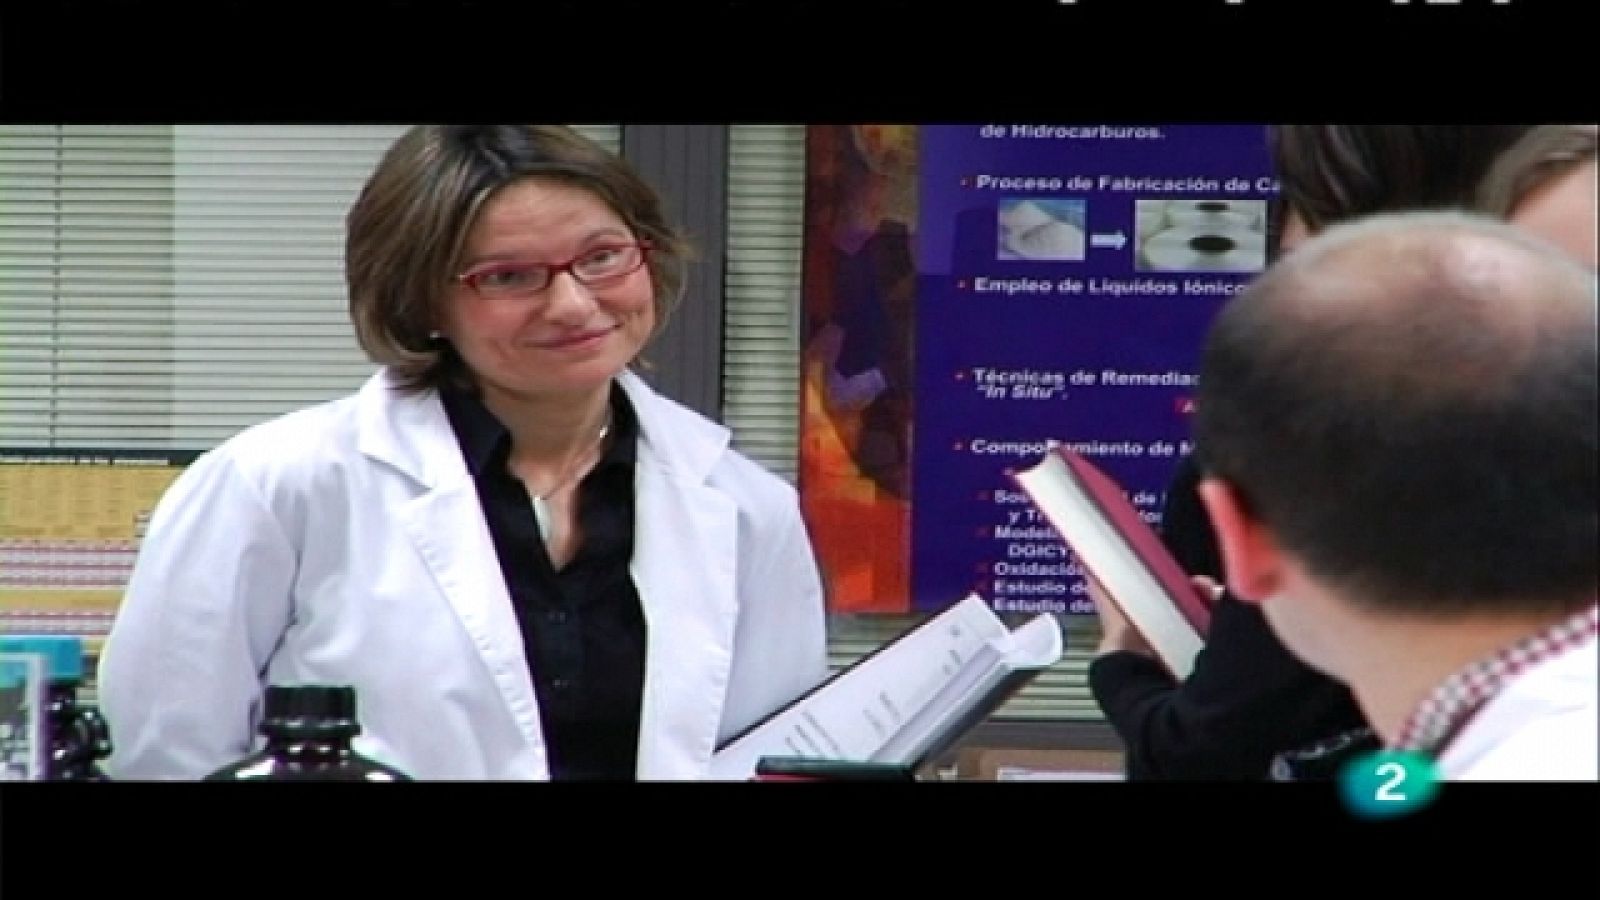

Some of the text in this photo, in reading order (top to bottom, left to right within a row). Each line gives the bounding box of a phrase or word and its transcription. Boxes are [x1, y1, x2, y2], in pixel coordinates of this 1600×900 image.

[980, 125, 1006, 139] de
[976, 175, 1062, 191] Proceso
[1067, 176, 1093, 191] de
[1099, 175, 1219, 192] Fabricación
[1224, 176, 1251, 192] de
[974, 277, 1053, 295] Empleo
[1058, 278, 1083, 293] de
[973, 368, 1065, 386] Técnicas
[1069, 370, 1095, 386] de
[1149, 440, 1176, 457] de
[994, 579, 1067, 594] Estudio
[994, 597, 1067, 613] Estudio
